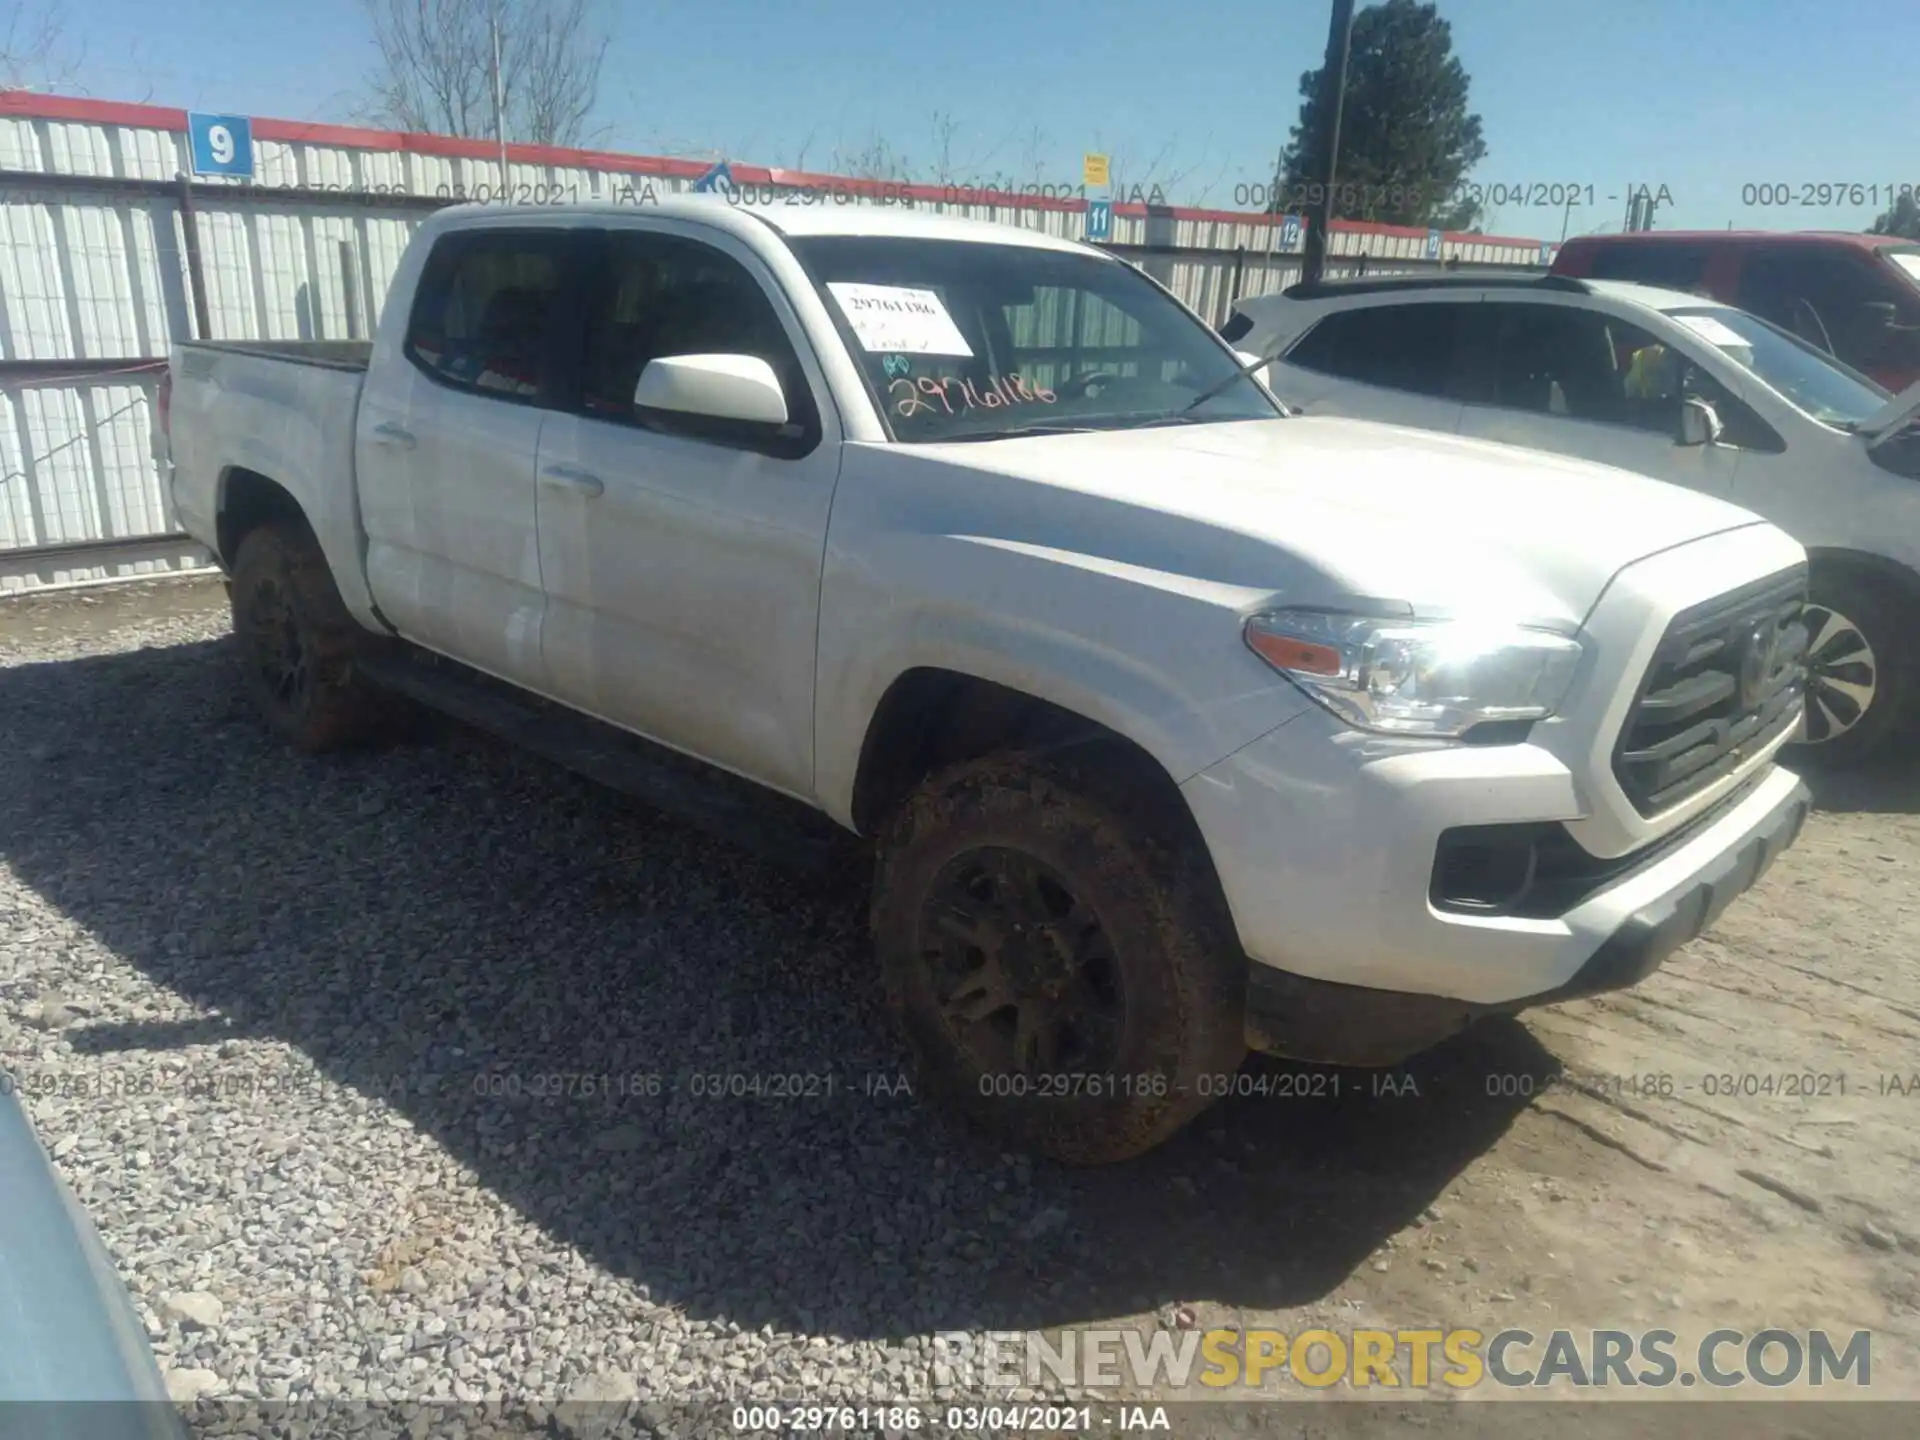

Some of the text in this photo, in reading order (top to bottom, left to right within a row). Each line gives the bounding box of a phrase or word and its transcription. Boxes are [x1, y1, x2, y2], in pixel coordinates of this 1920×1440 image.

[209, 125, 234, 163] 9
[1091, 207, 1108, 231] 11
[1284, 222, 1298, 244] 12
[850, 297, 936, 315] 29761186
[888, 372, 1057, 417] 29761186
